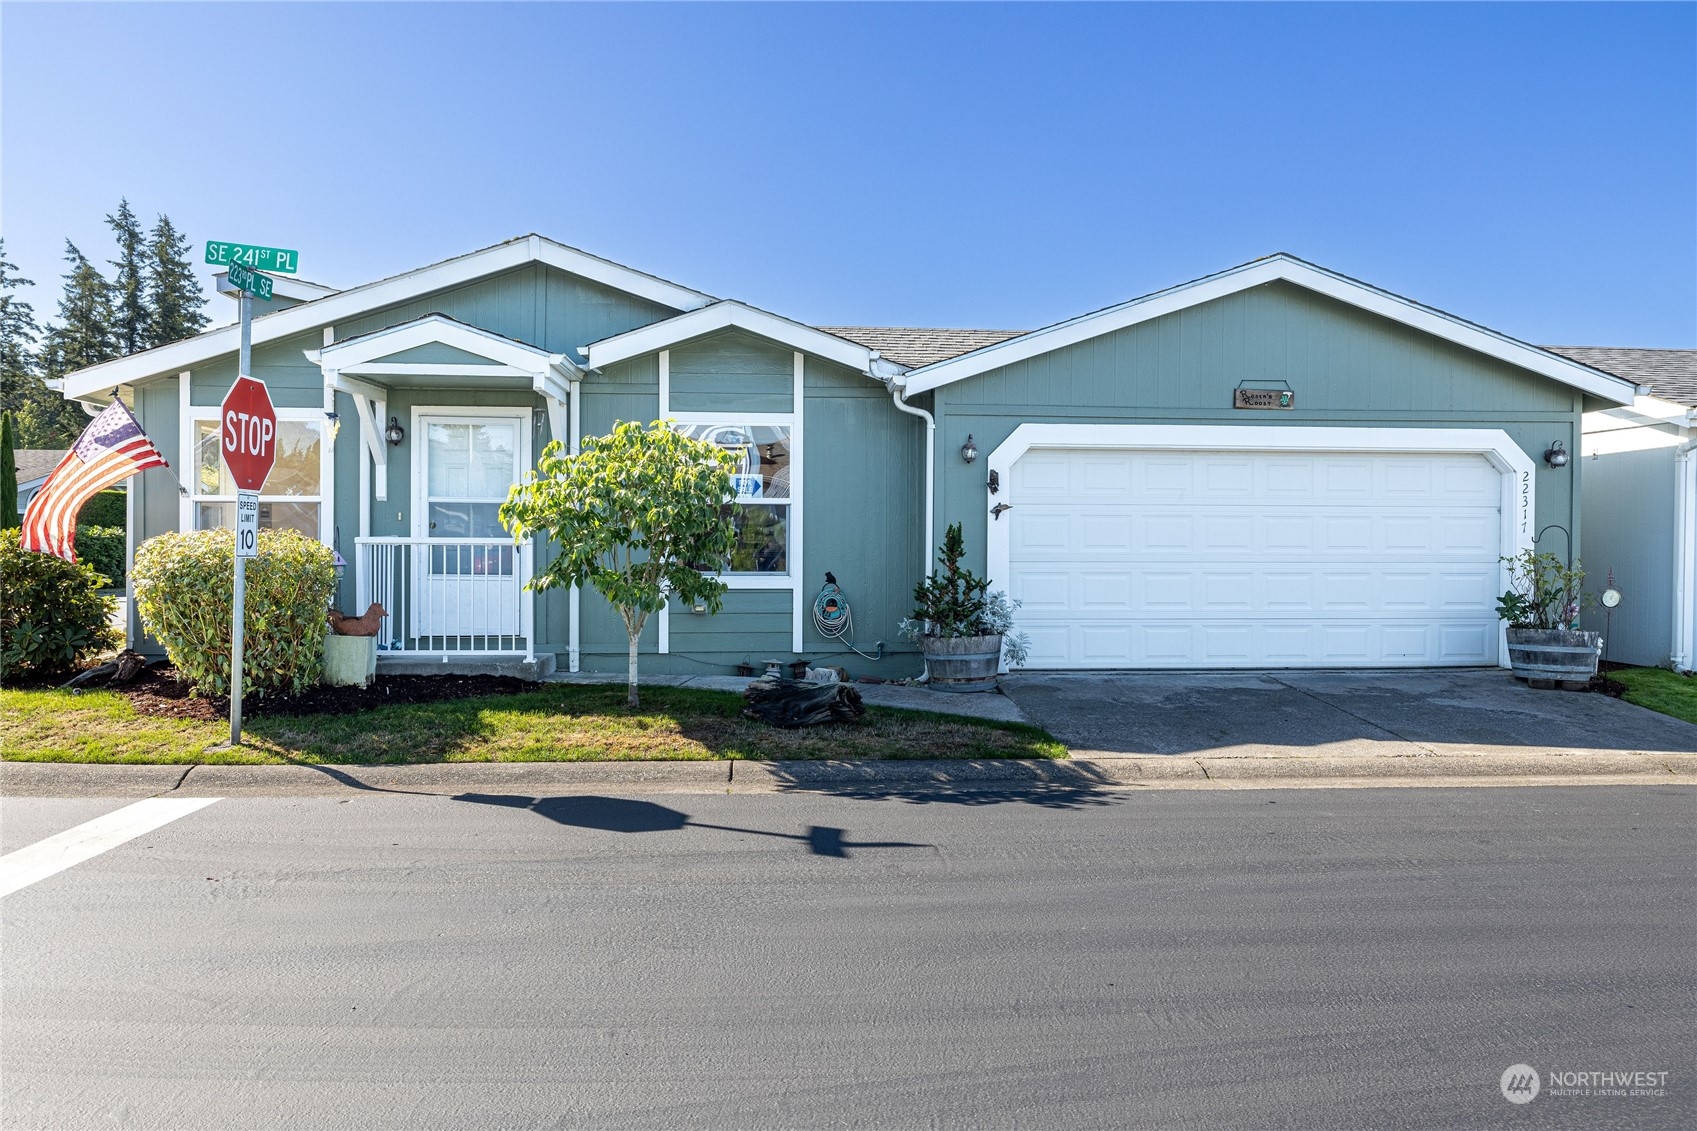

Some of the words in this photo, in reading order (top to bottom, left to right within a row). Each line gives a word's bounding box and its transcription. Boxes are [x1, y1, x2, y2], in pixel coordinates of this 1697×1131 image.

[208, 244, 228, 262] SE
[233, 247, 271, 266] 241ST
[276, 252, 295, 270] PL
[246, 272, 256, 292] PL
[260, 279, 272, 297] SE
[225, 410, 273, 457] STOP
[240, 501, 256, 510] SPEED
[1521, 471, 1529, 533] 22317
[241, 514, 254, 522] LIMIT
[241, 529, 254, 549] 10
